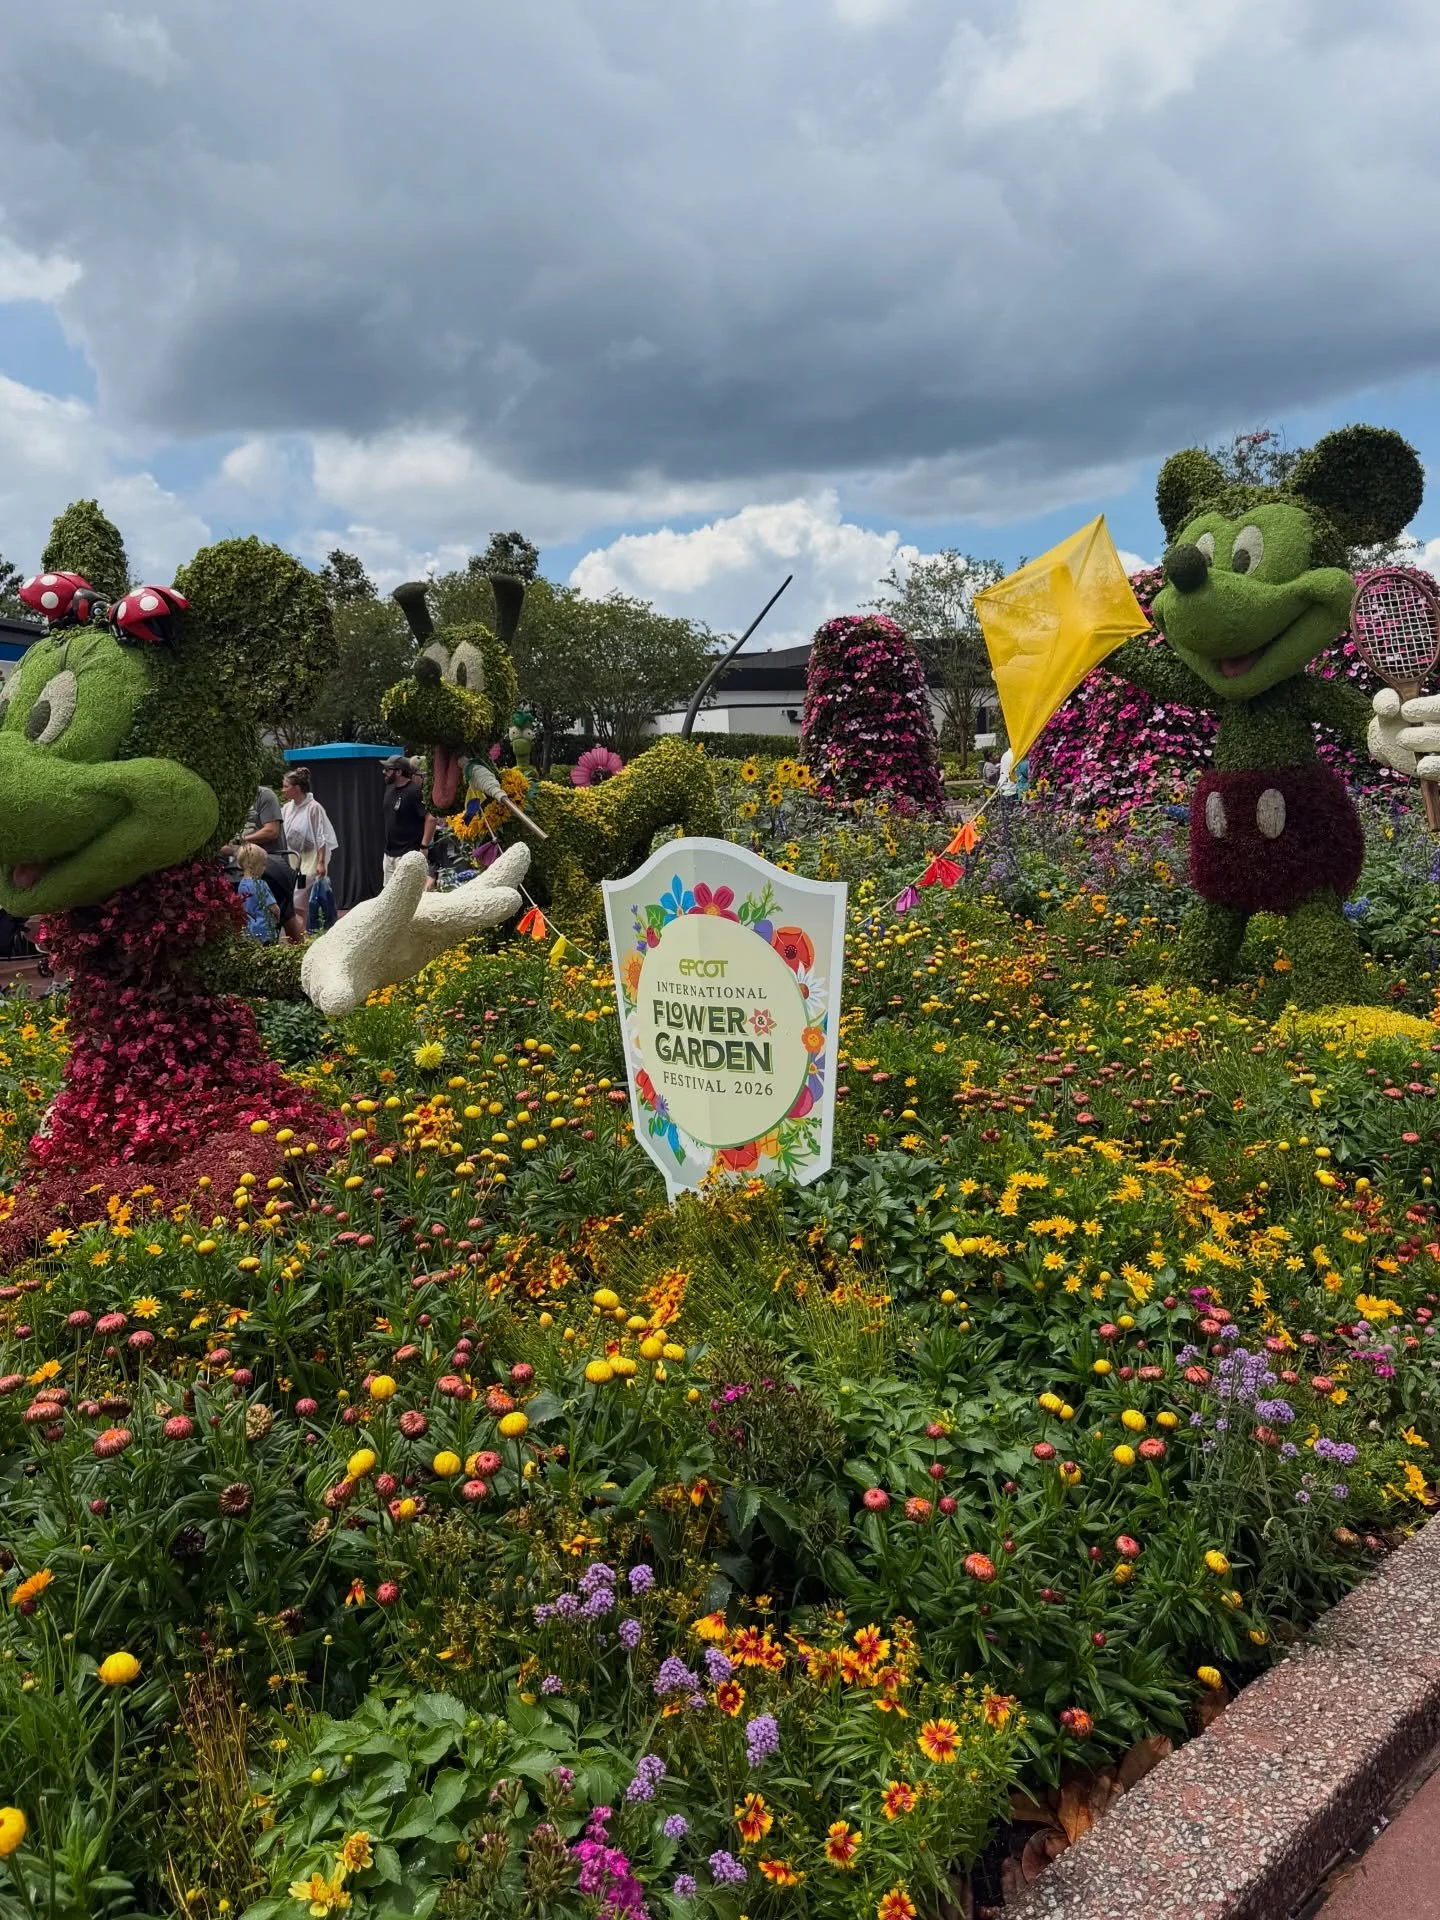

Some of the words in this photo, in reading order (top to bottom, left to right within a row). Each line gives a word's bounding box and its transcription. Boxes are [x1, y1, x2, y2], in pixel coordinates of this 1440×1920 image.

[679, 958, 728, 978] EPCOT
[657, 981, 767, 999] INTERNATIONAL
[653, 999, 748, 1036] FLOWER
[655, 1032, 773, 1074] GARDEN
[663, 1071, 726, 1093] FESTIVAL
[735, 1081, 773, 1096] 2026
